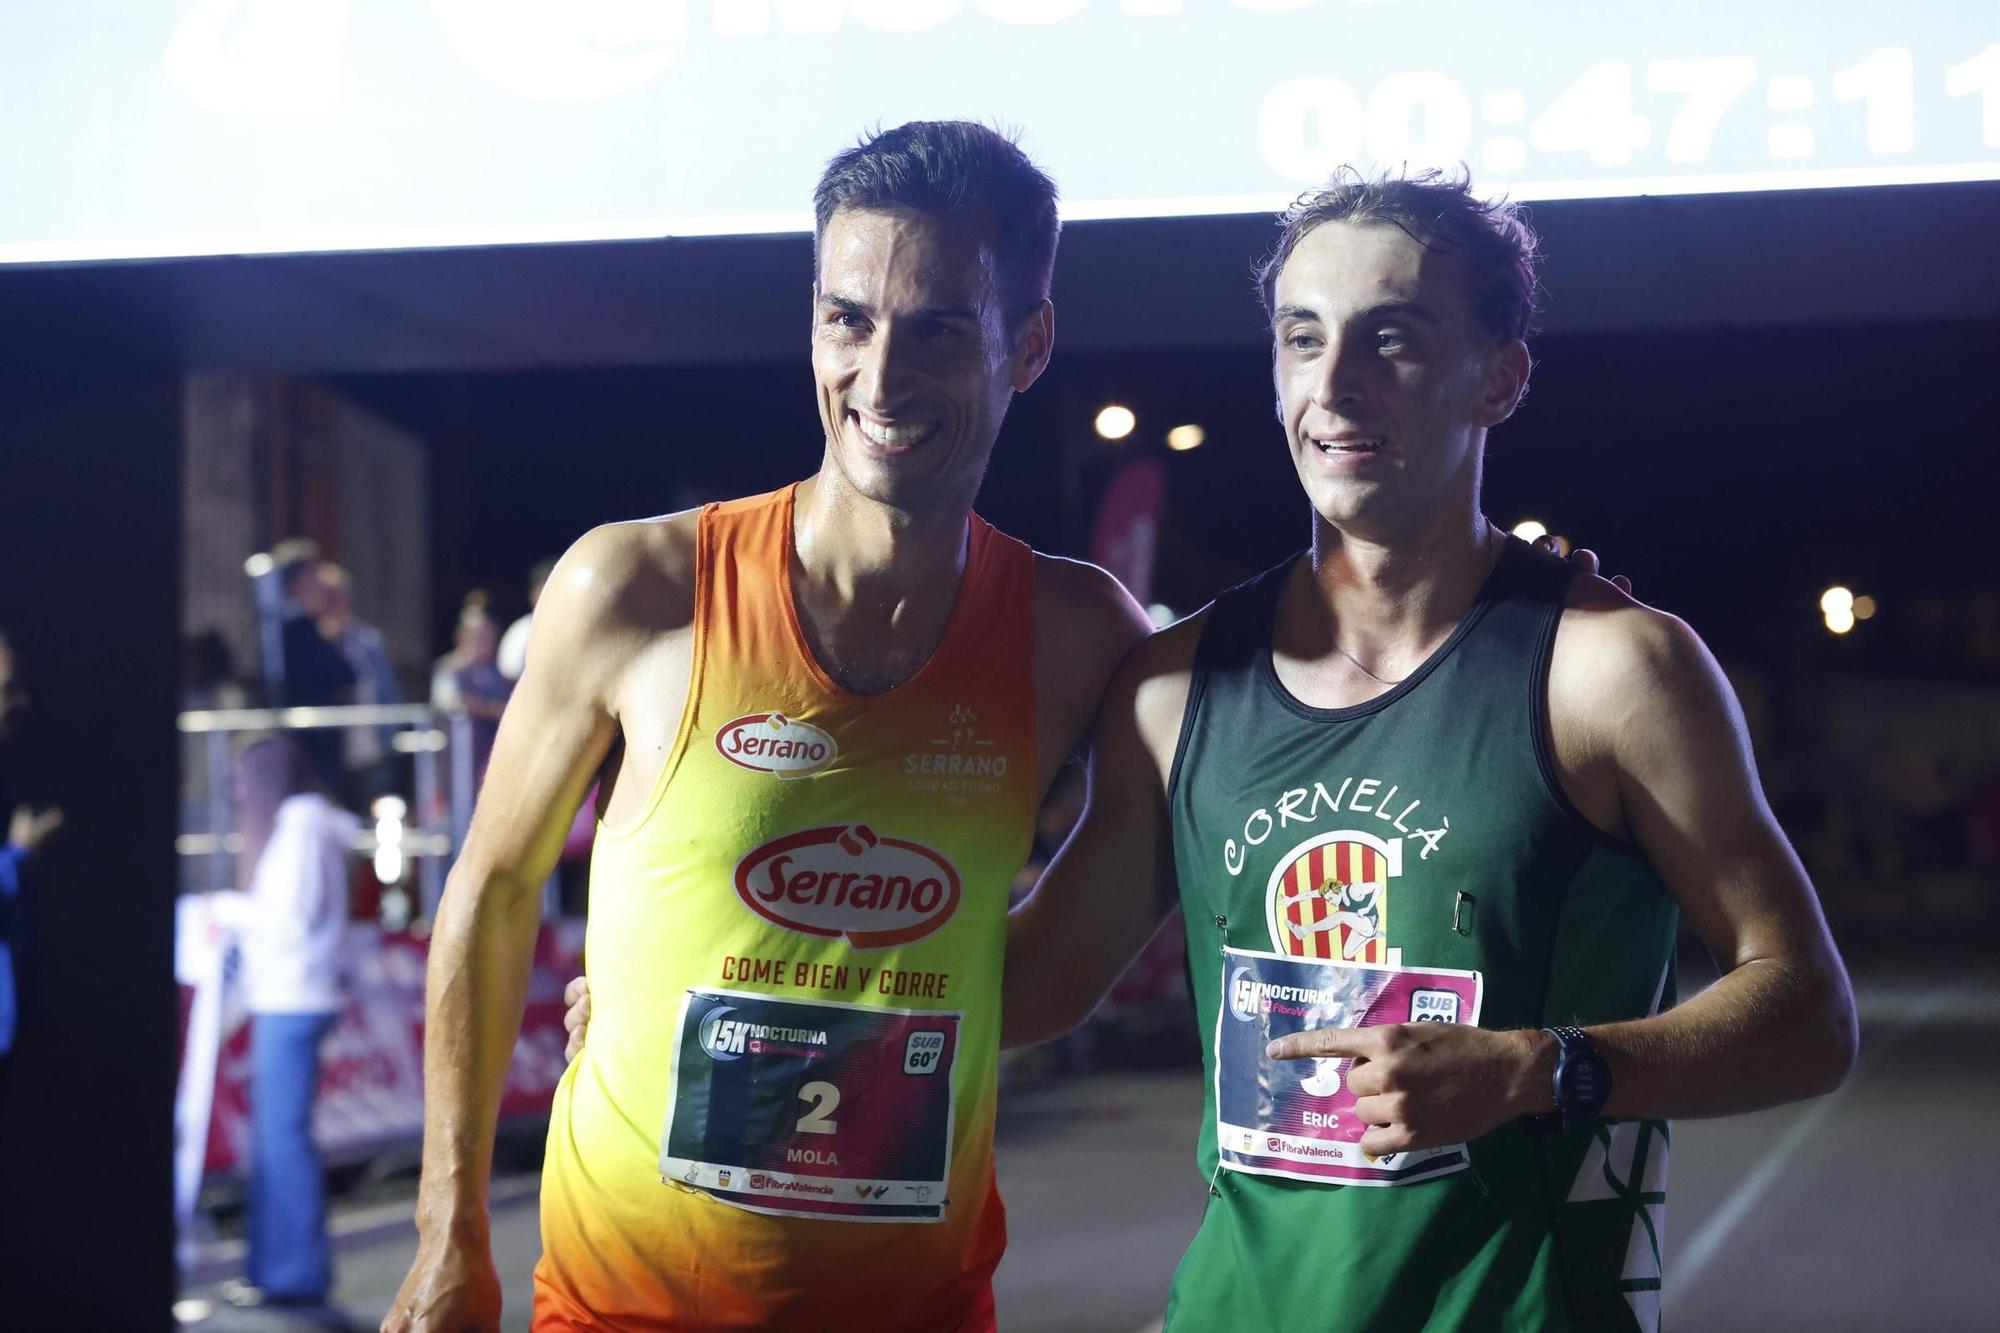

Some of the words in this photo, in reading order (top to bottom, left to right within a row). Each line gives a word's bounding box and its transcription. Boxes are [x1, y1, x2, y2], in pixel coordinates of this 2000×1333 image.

[726, 728, 826, 762] Serrano
[904, 752, 1008, 777] SERRANO
[1224, 777, 1450, 876] CORNELLÀ
[755, 855, 944, 914] Serrano
[722, 955, 786, 985] COME
[794, 962, 849, 991] BIEN
[857, 967, 872, 992] Y
[878, 969, 949, 999] CORRE
[1415, 995, 1454, 1011] SUB
[706, 1018, 749, 1054] 15K
[750, 1023, 828, 1046] NOCTURNA
[911, 1036, 942, 1049] SUB
[795, 1080, 841, 1135] 2
[1302, 1111, 1340, 1129] ERIC
[786, 1148, 838, 1166] MOLA
[1281, 1137, 1344, 1159] FibraValencia
[764, 1176, 834, 1196] FibraValencia
